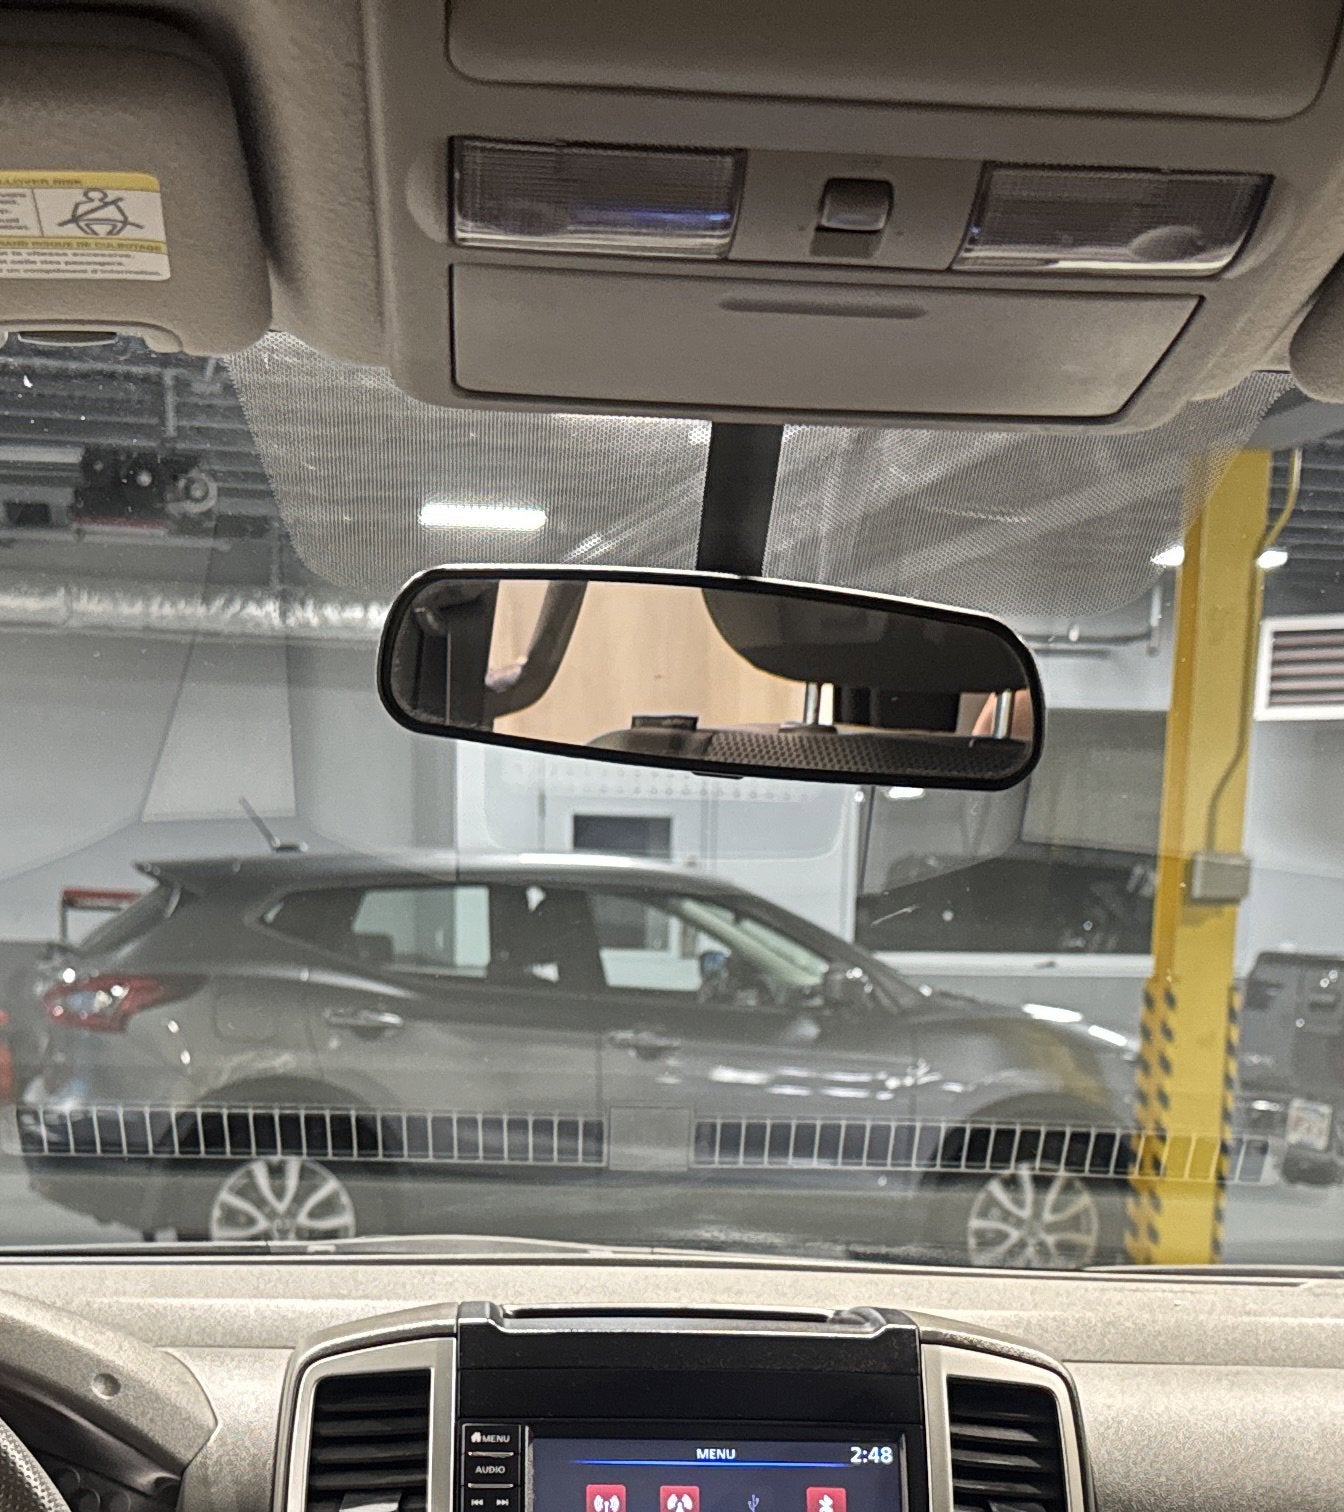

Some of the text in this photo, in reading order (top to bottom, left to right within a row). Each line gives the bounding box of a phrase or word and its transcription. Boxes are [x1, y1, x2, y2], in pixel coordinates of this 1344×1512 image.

[482, 1434, 511, 1443] MENU
[696, 1448, 736, 1460] MENU
[849, 1446, 893, 1464] 2:48
[474, 1465, 506, 1474] AUDIO
